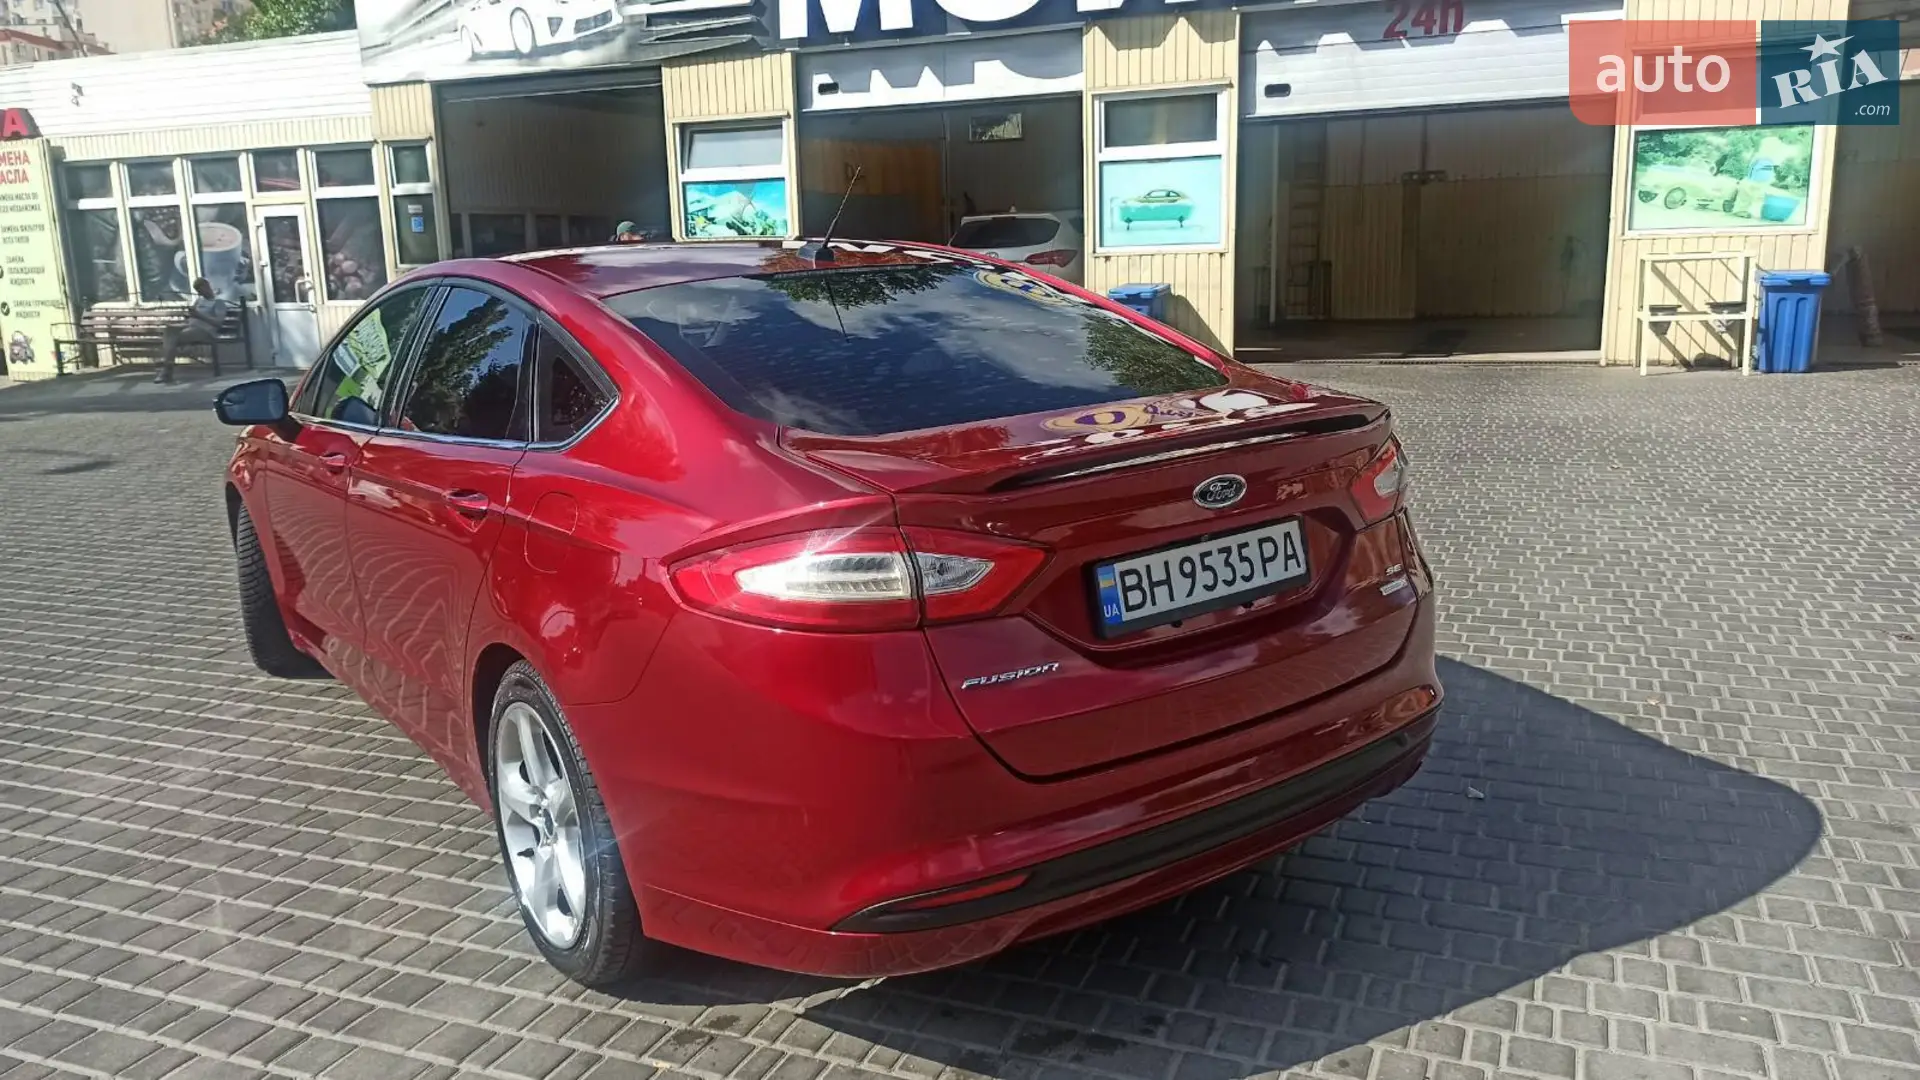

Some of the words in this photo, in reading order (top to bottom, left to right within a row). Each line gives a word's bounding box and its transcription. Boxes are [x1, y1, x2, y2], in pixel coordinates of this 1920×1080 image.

[1207, 481, 1237, 501] Ford
[1179, 541, 1255, 599] 9535
[1103, 603, 1121, 618] UA
[961, 662, 1059, 690] FUSION
